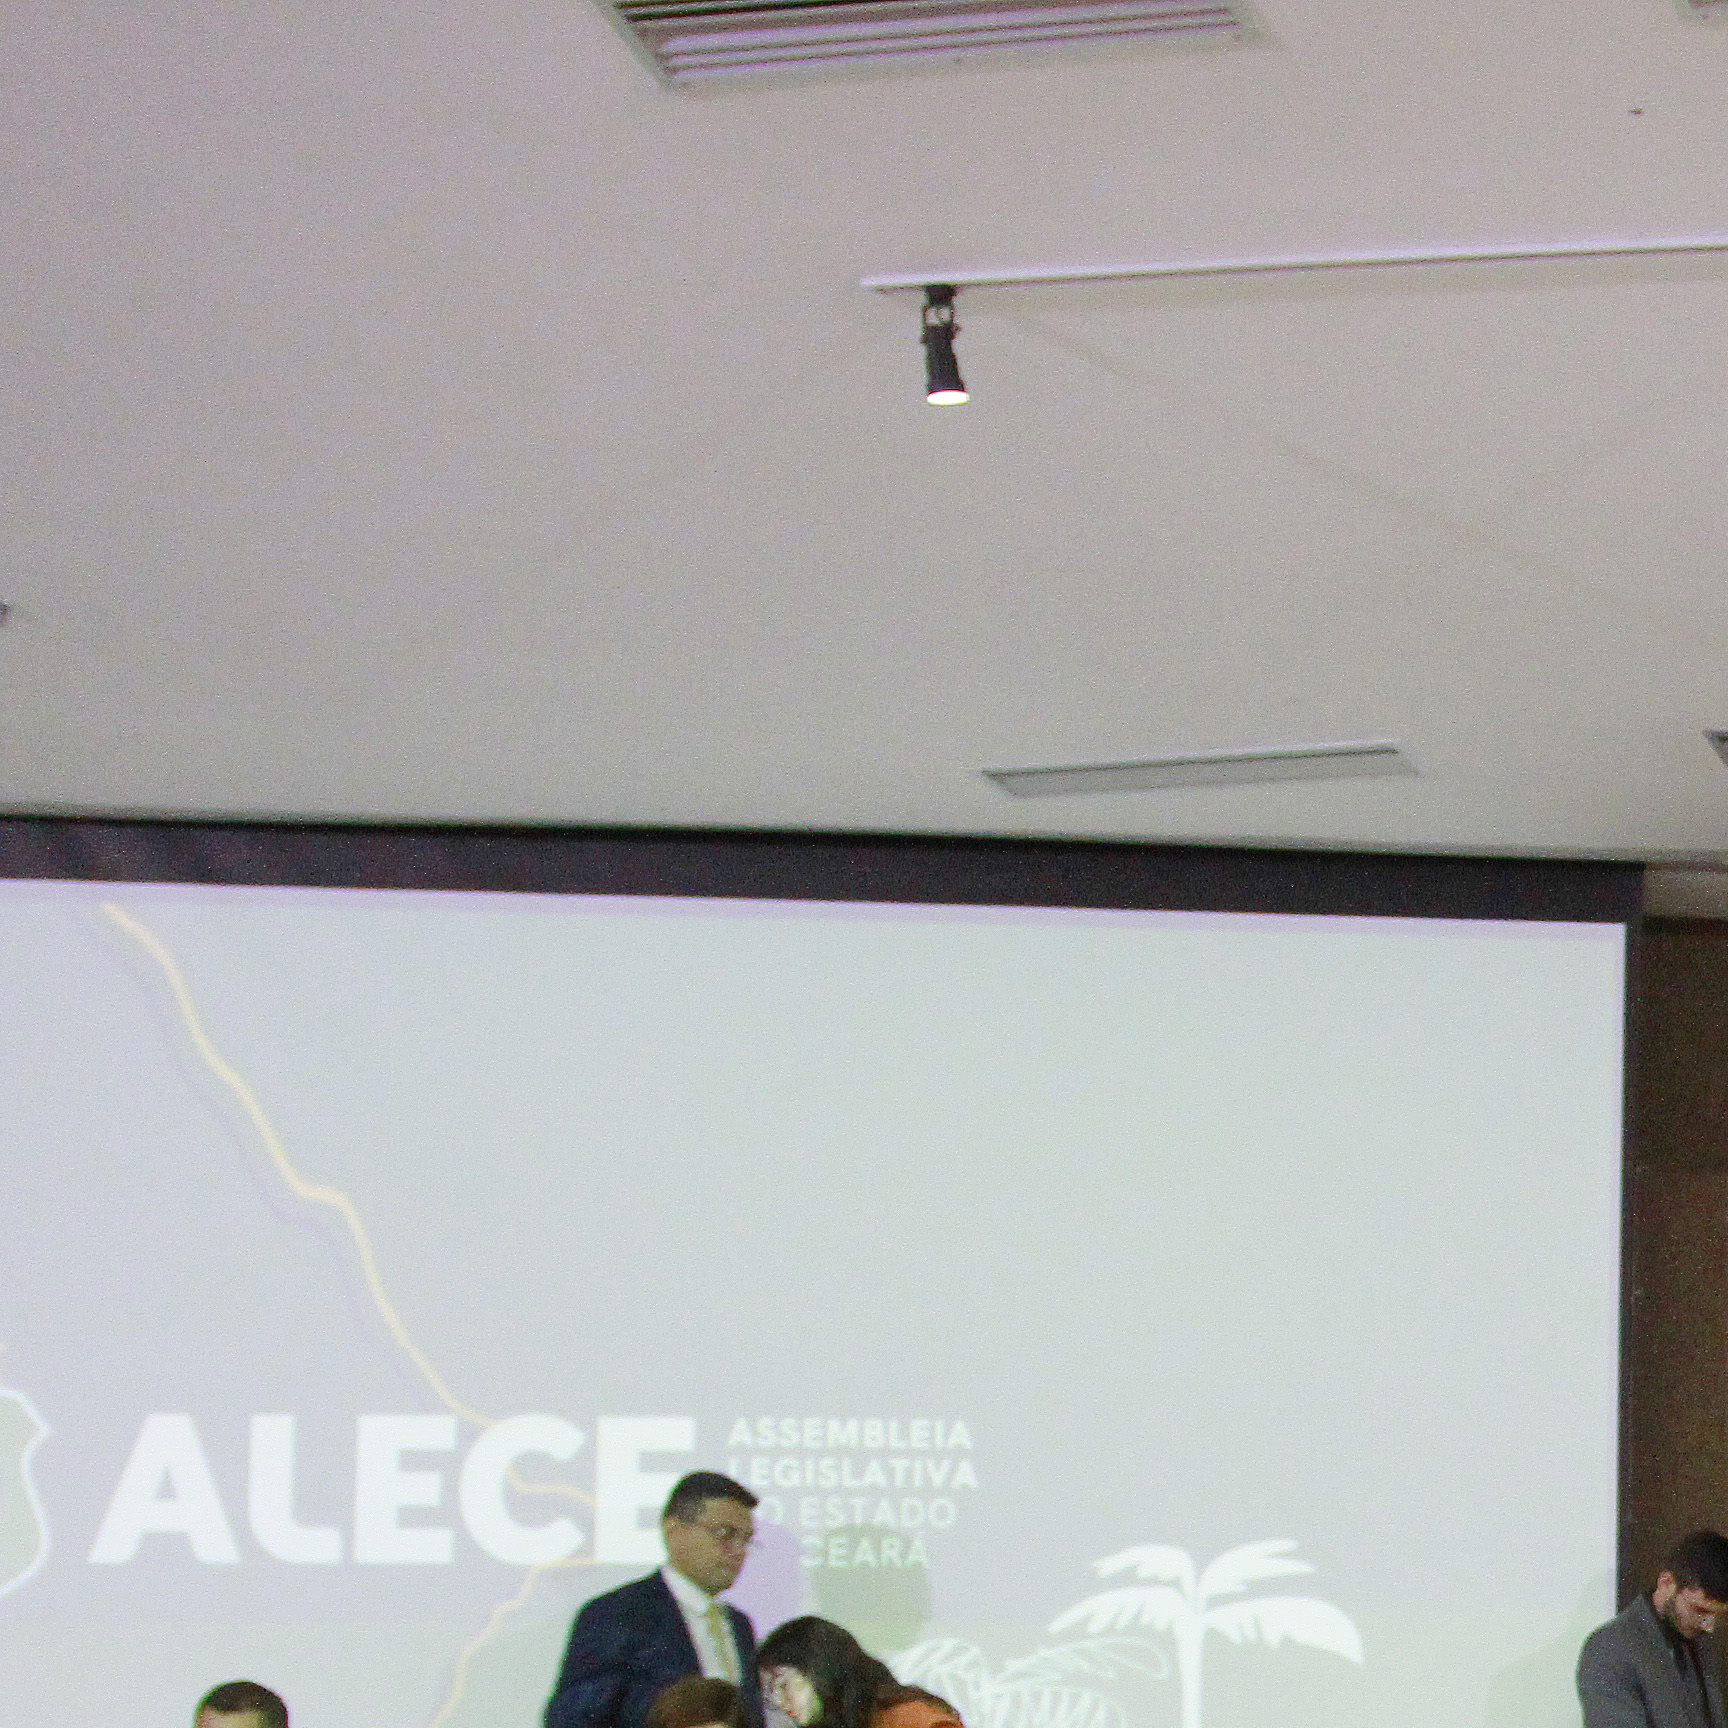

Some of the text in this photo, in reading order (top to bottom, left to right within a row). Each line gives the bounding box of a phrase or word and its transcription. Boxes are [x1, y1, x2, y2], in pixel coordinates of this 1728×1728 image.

[727, 1416, 974, 1449] ASSEMBLEIA
[86, 1412, 695, 1566] ALECE
[800, 1497, 956, 1528] ESTADO
